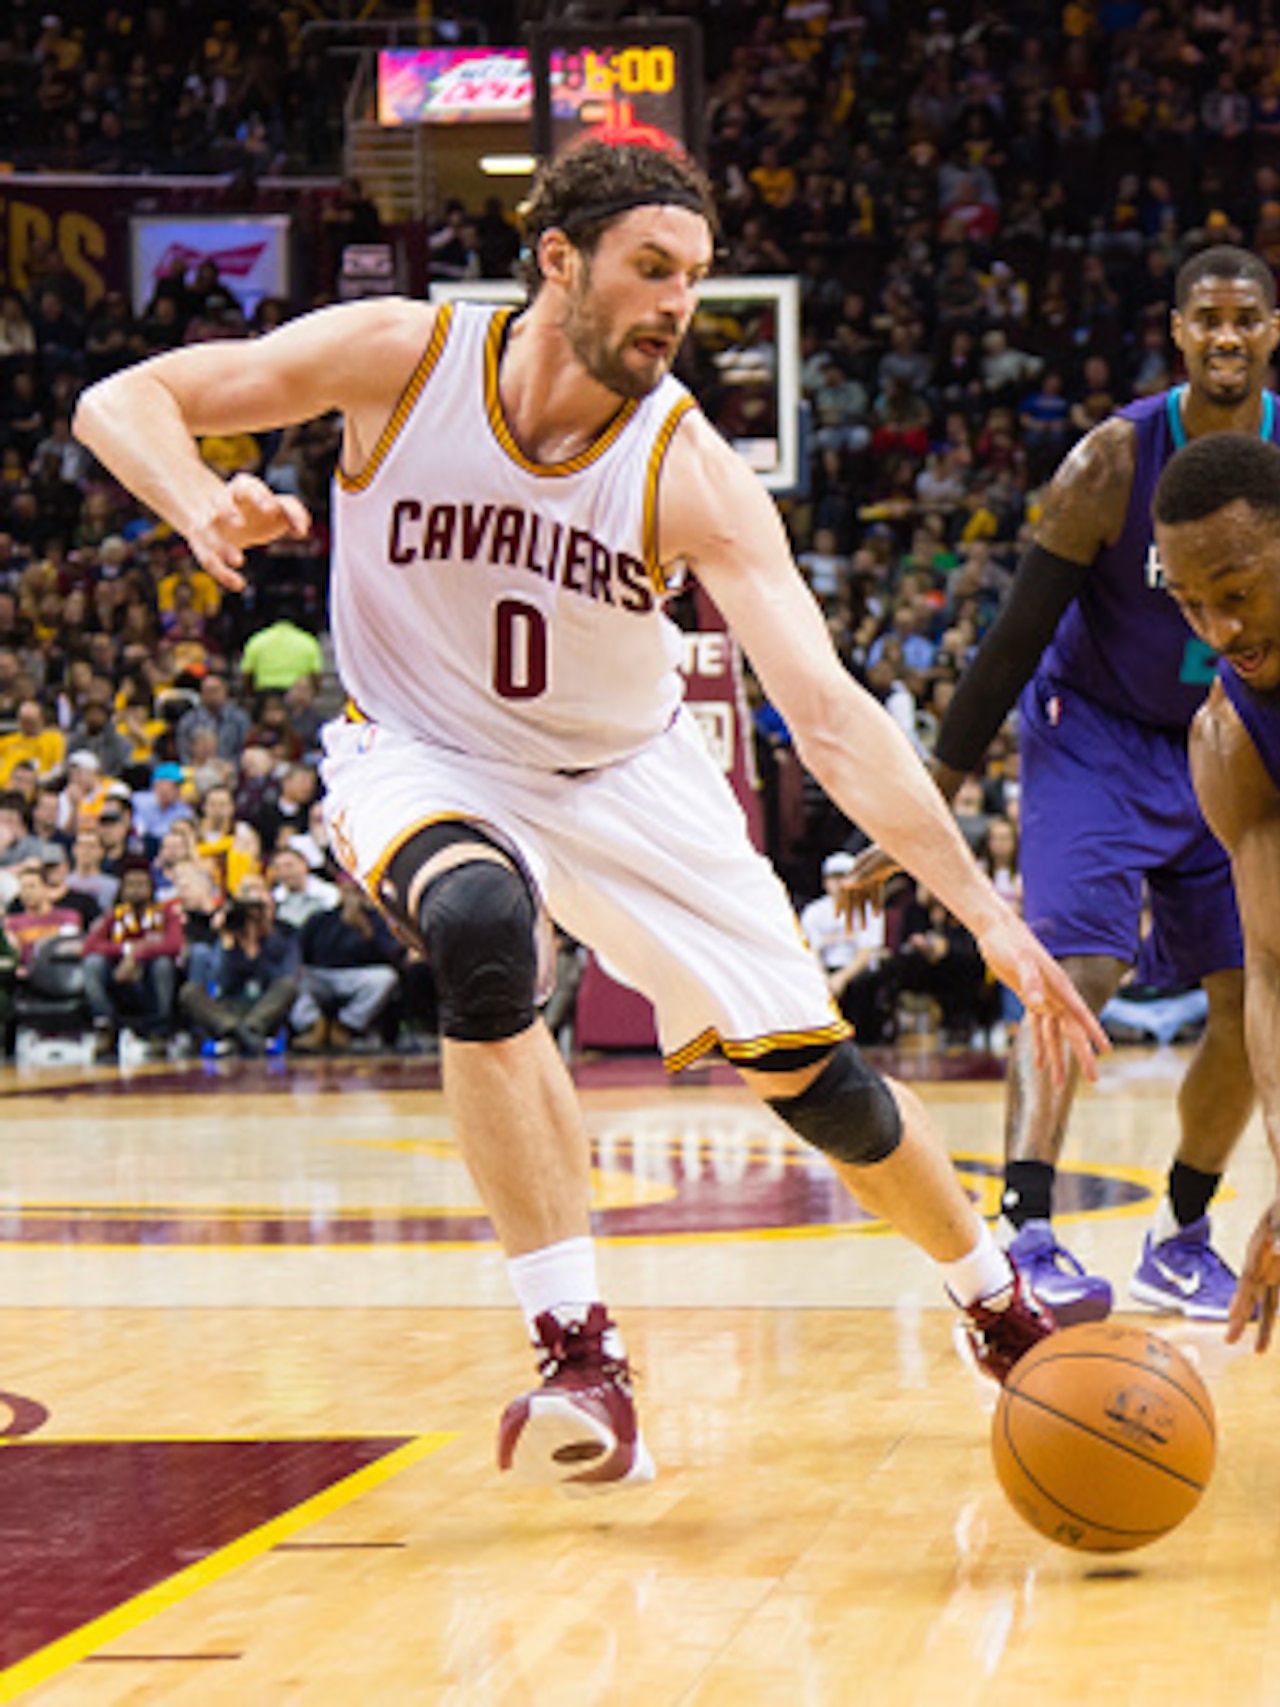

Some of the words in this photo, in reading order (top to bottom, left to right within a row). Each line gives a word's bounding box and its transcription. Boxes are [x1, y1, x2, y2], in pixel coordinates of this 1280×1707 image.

[584, 46, 675, 93] 6:00
[388, 498, 653, 616] CAVALIERS
[492, 598, 548, 700] 0
